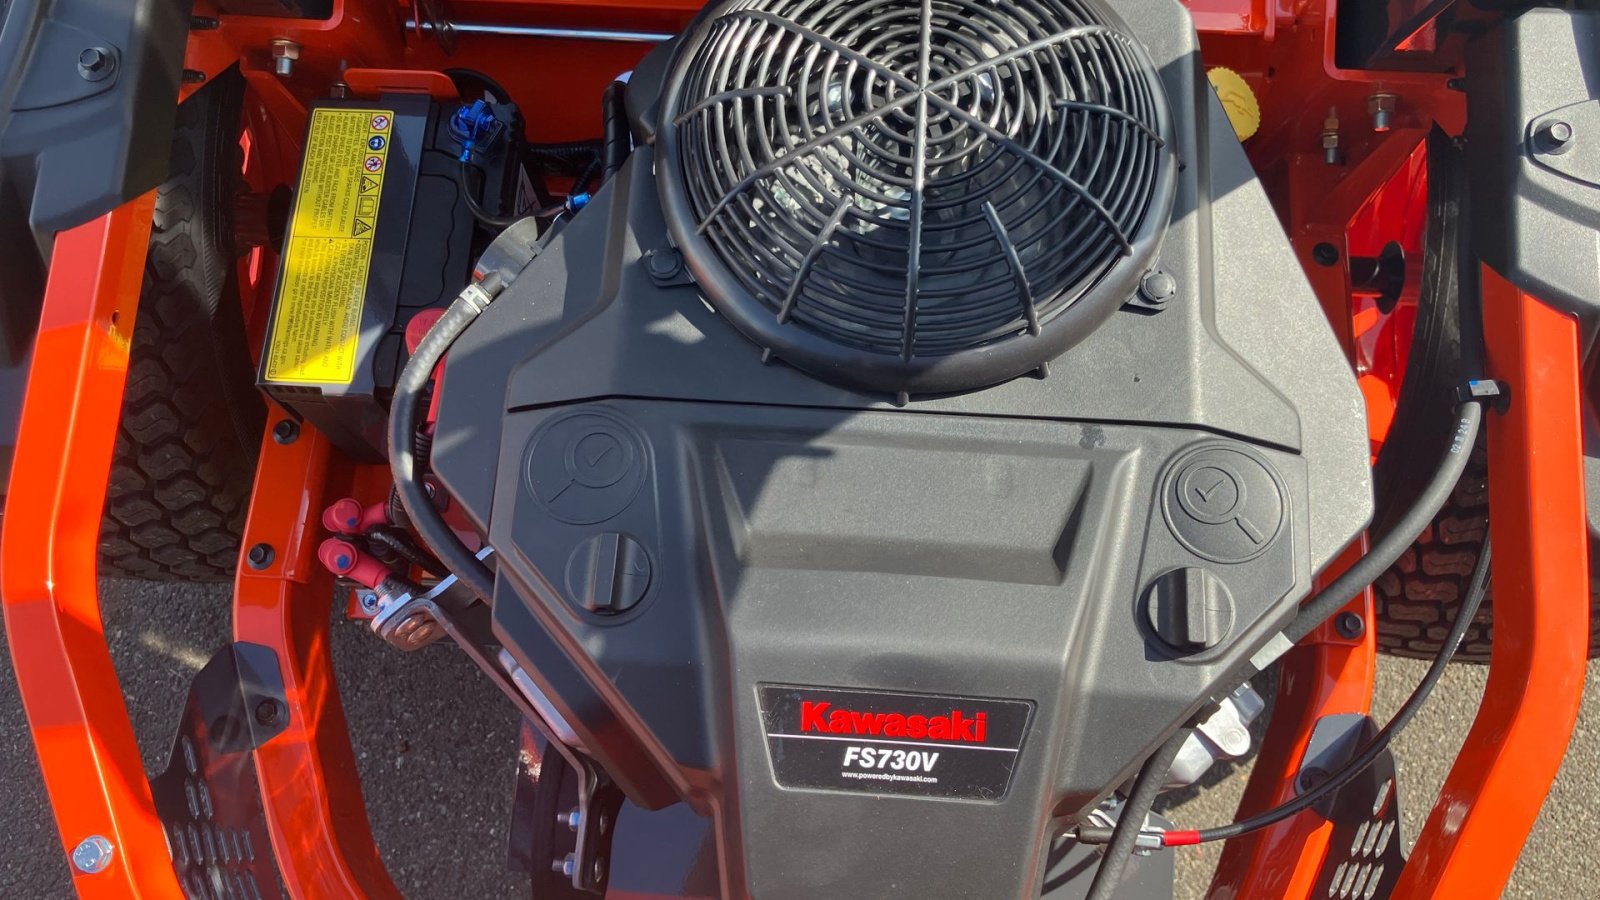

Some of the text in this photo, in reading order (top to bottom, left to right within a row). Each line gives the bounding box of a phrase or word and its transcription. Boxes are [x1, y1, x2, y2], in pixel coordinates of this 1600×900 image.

[801, 701, 987, 743] Kawasaki
[843, 746, 940, 772] FS730V
[841, 771, 938, 783] www.poweredbykawasaki.com
